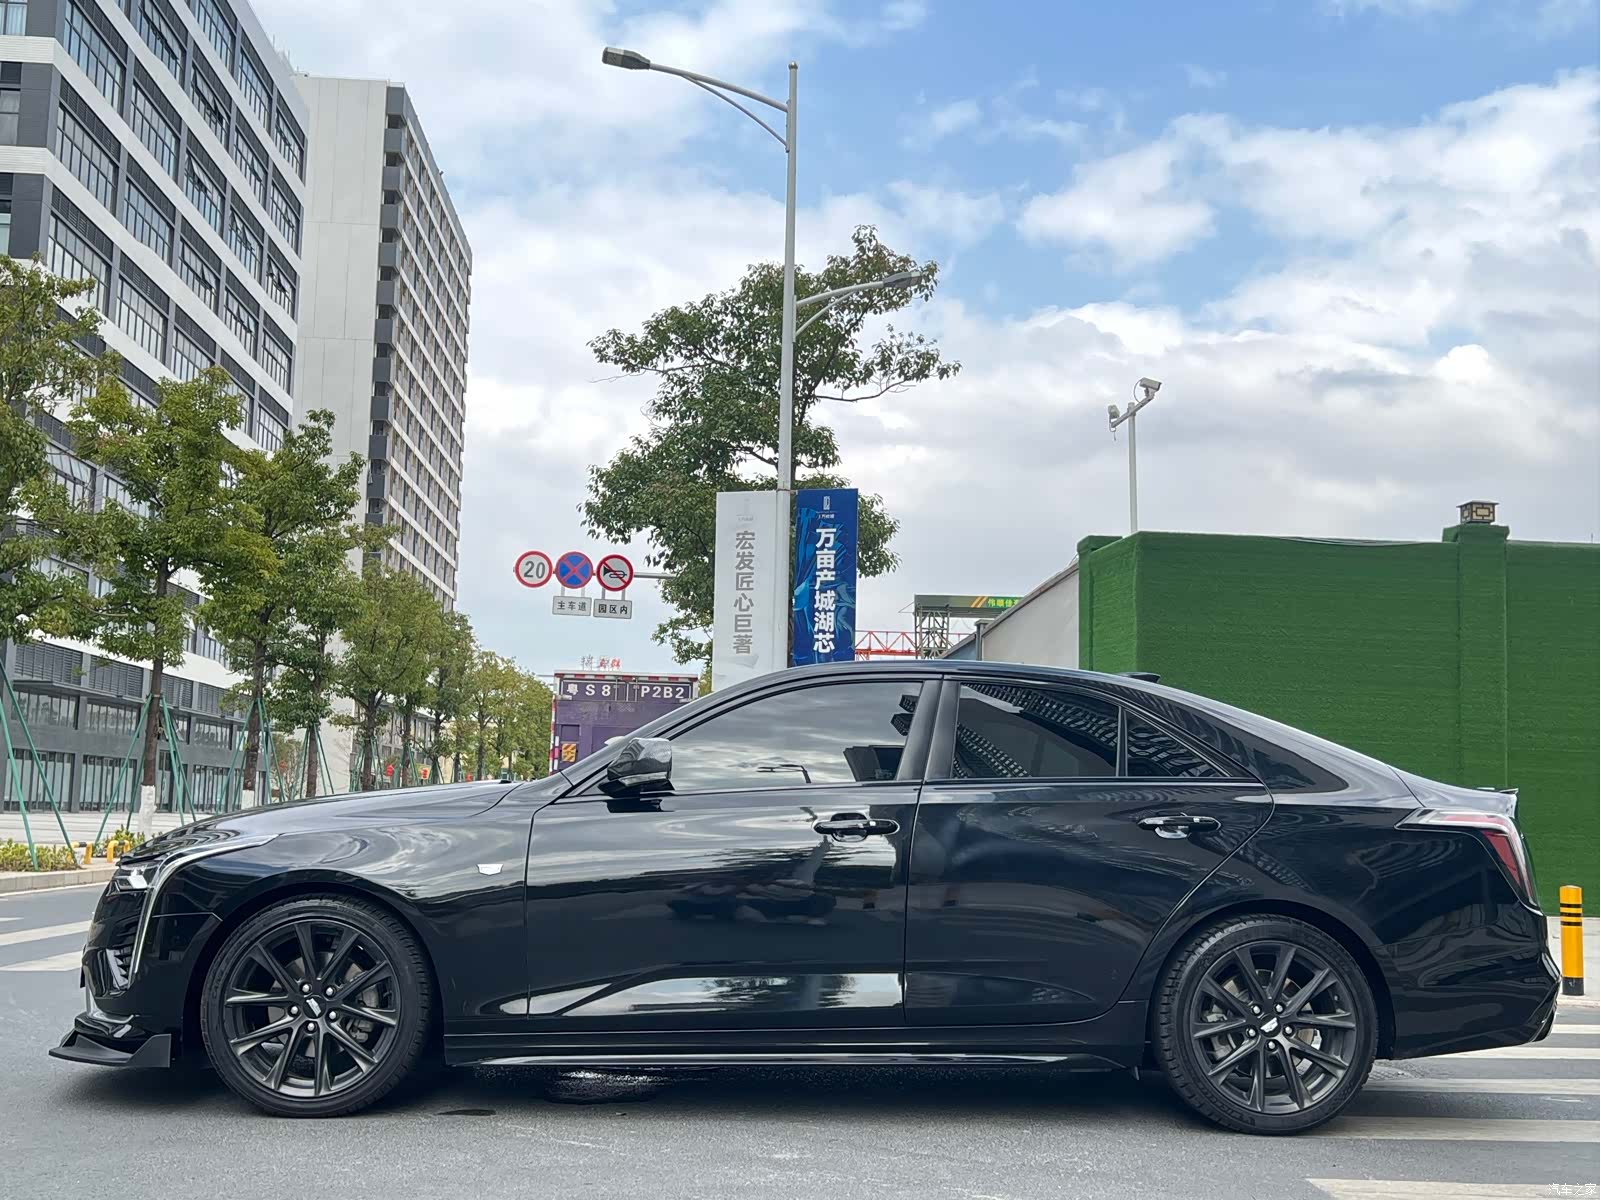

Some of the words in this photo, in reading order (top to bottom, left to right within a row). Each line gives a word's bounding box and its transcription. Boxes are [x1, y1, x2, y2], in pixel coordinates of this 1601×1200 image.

[523, 560, 546, 579] 20
[813, 527, 837, 654] 万亩产城湖芯
[556, 600, 587, 612] 主车道
[598, 603, 628, 615] 园区内
[640, 685, 685, 699] P2B2
